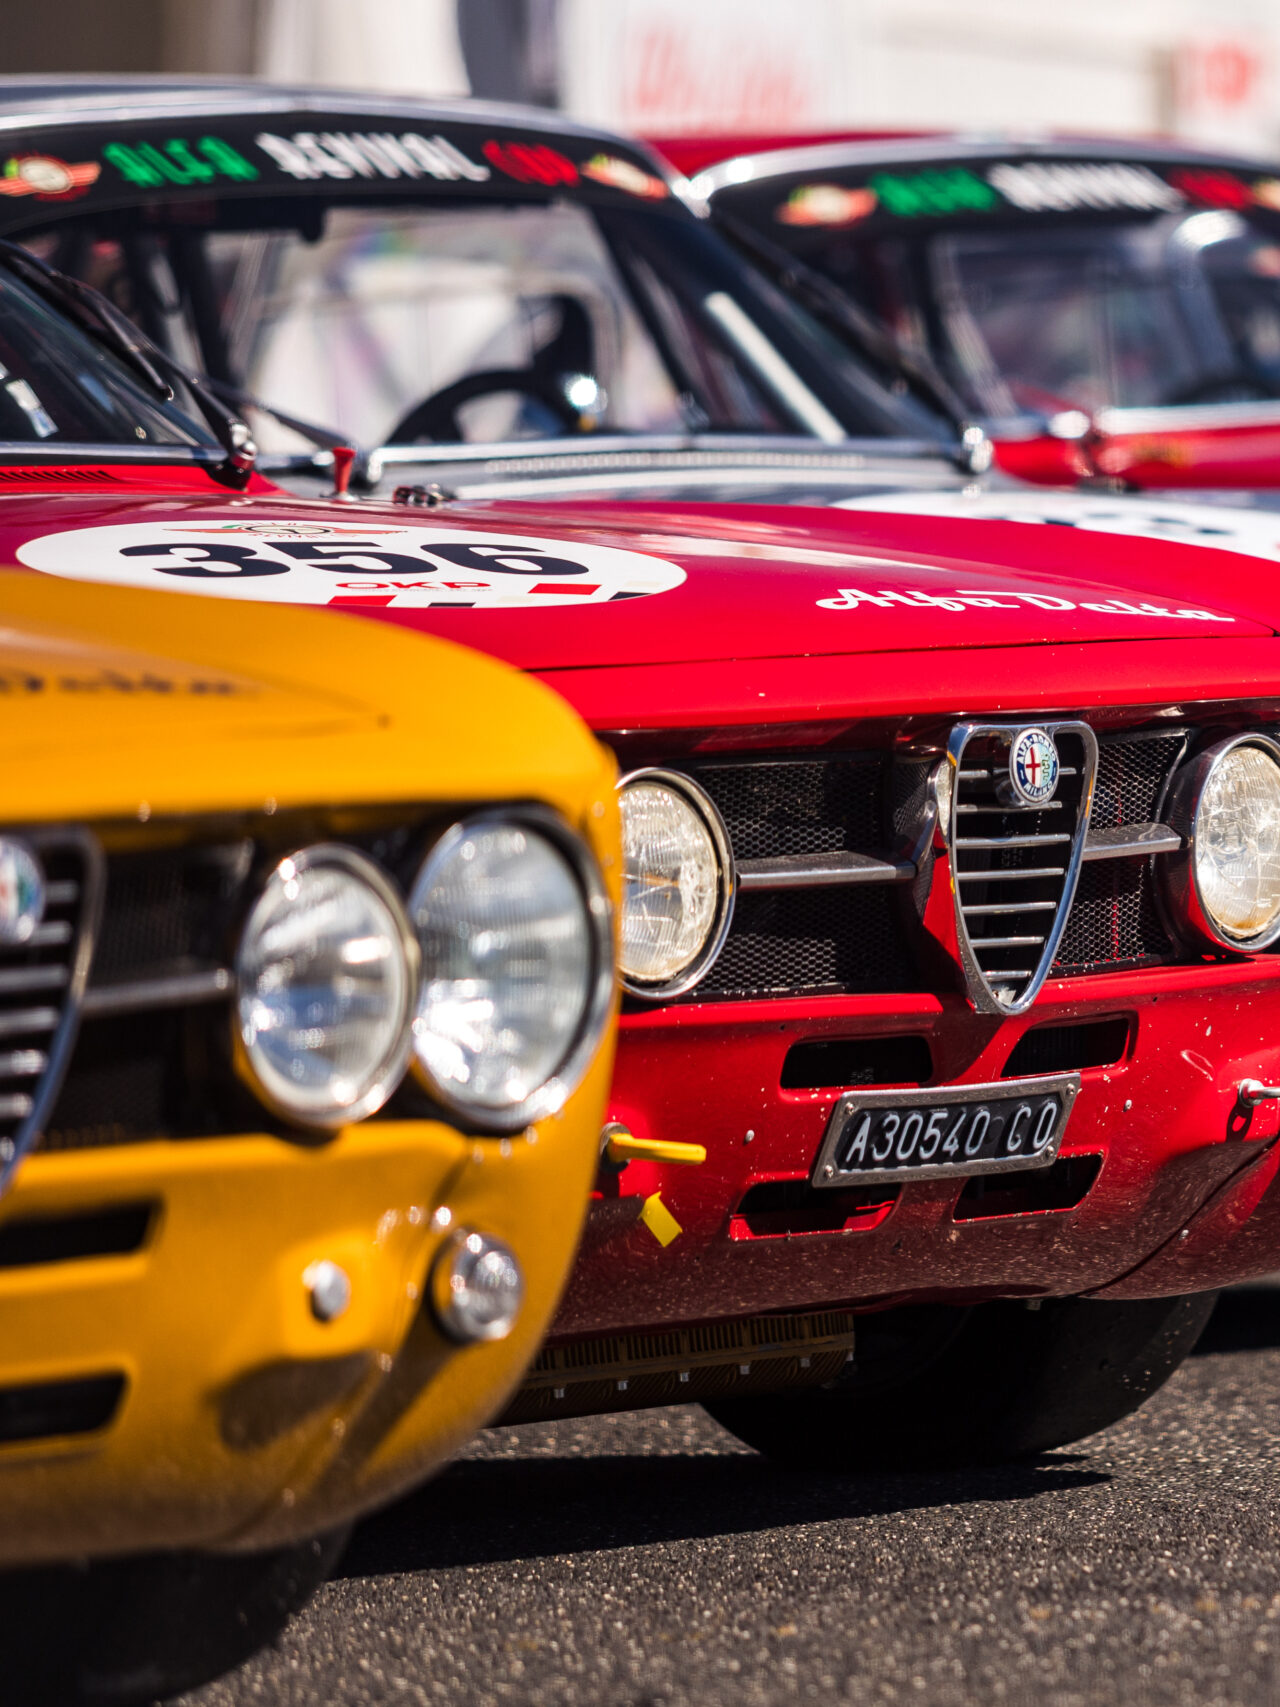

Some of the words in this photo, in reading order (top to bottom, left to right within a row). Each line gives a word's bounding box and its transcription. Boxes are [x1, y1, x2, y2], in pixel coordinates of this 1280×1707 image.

[118, 540, 590, 579] 356
[335, 581, 492, 589] OKP
[815, 588, 1020, 612] Alfa
[956, 589, 1236, 623] Delta
[846, 1110, 991, 1162] A30540
